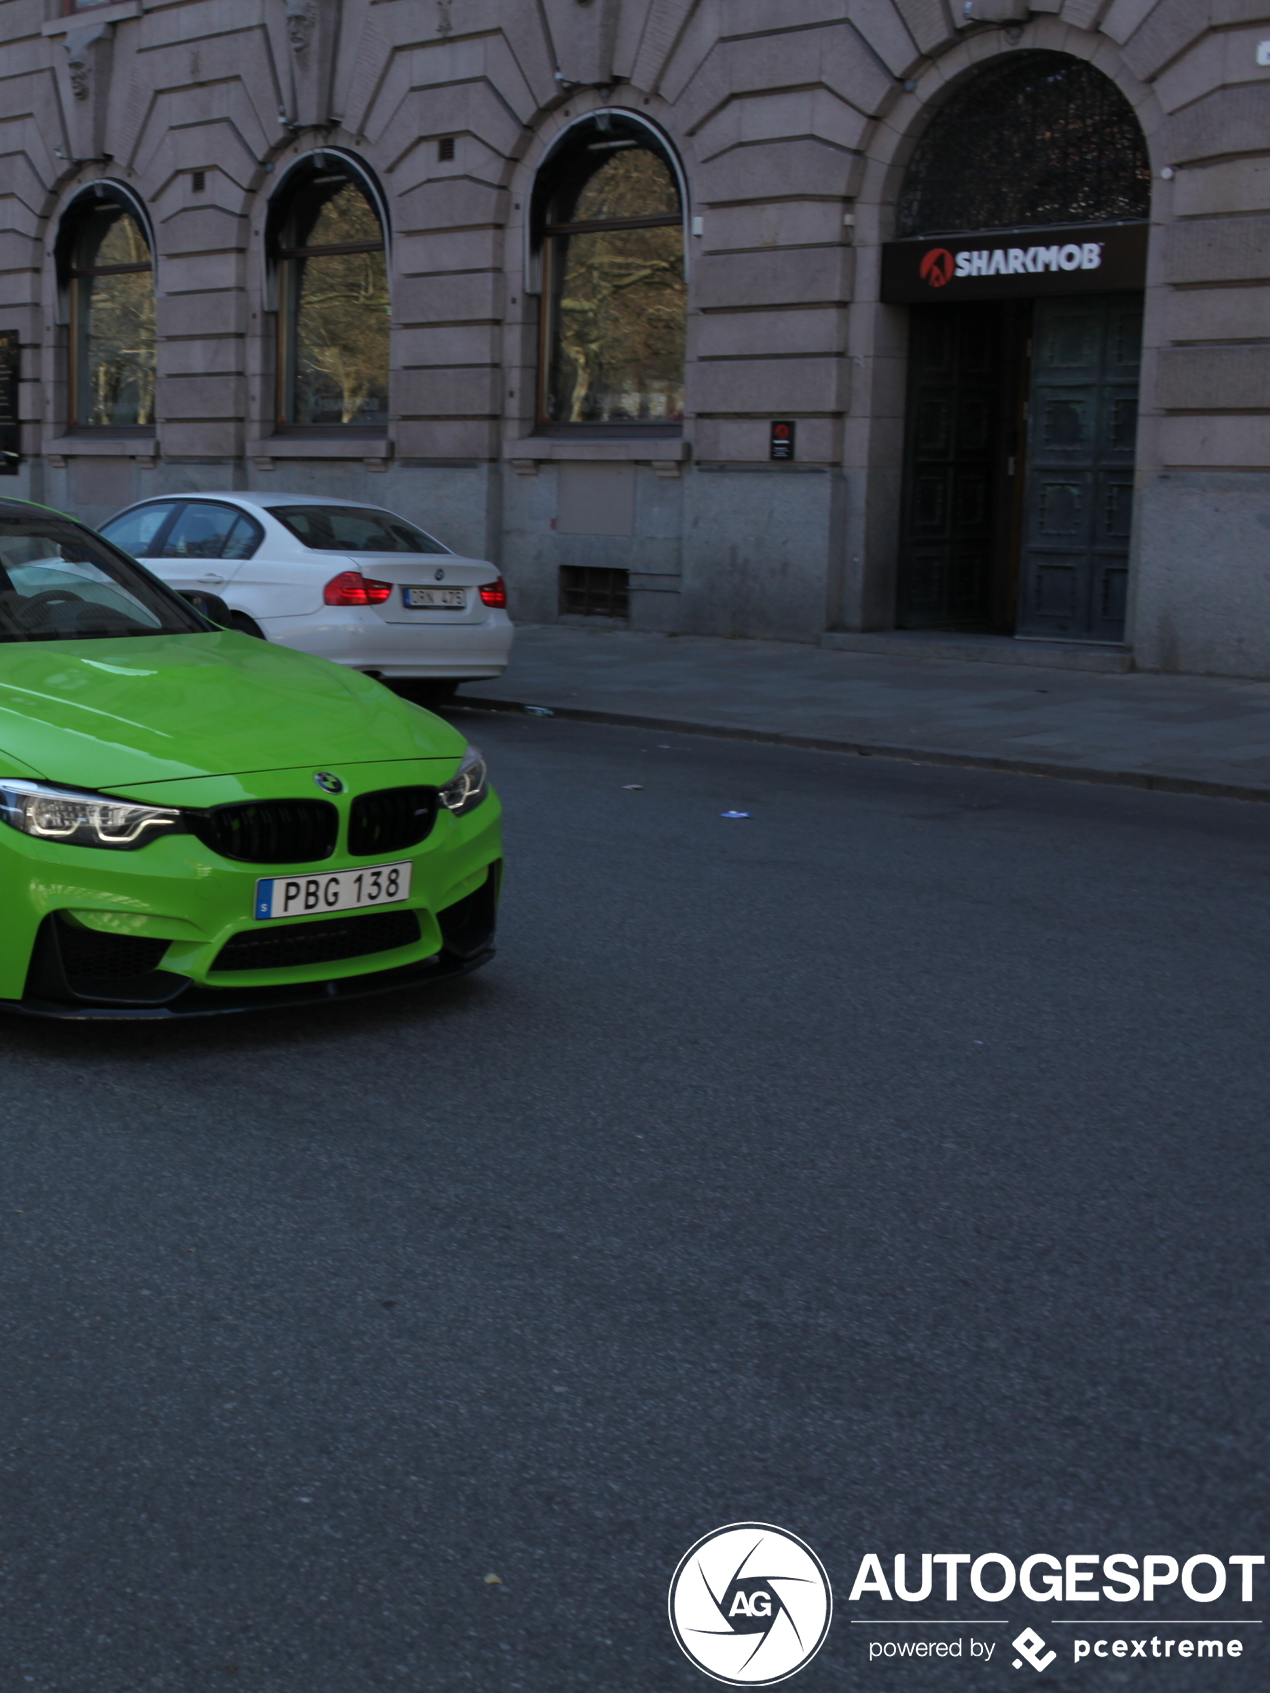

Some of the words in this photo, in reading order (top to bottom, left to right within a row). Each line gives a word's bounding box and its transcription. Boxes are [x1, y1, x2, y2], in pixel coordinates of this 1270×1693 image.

[954, 242, 1102, 277] SHARKMOB
[283, 876, 341, 913] PBG
[353, 868, 400, 903] 138
